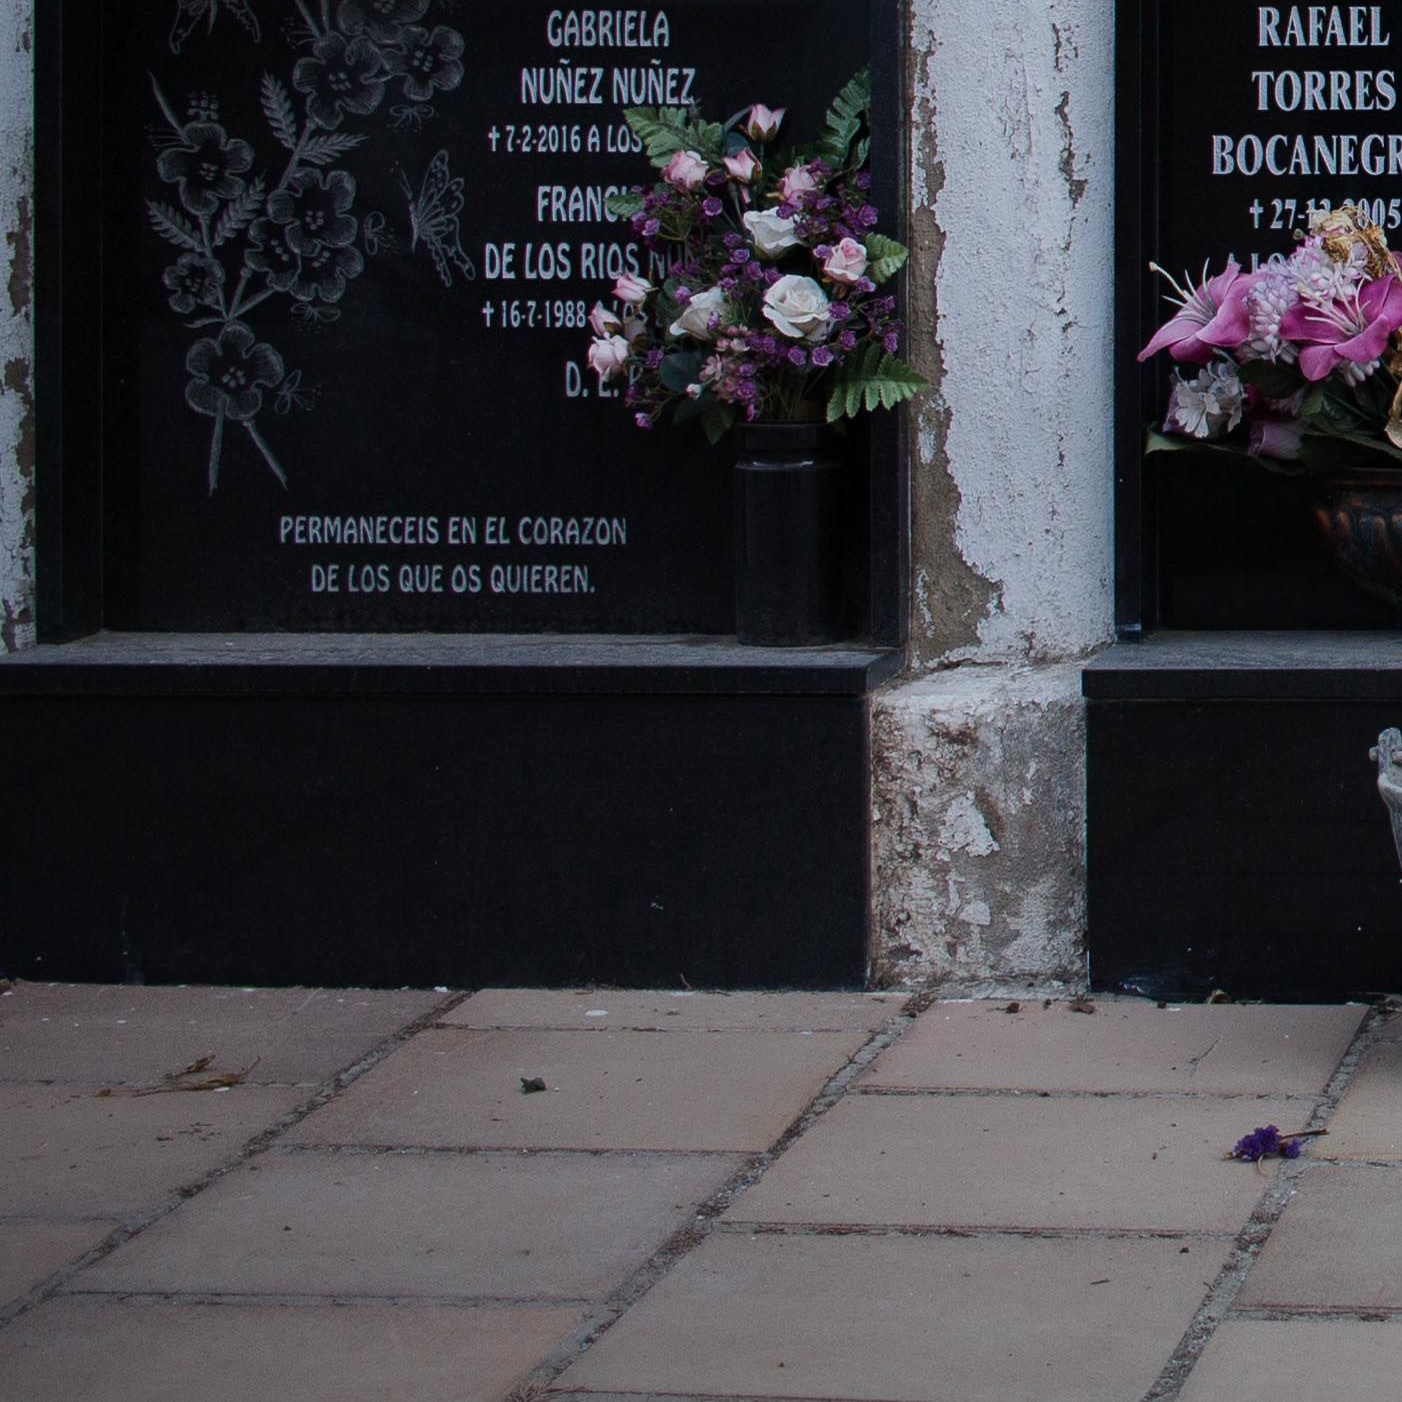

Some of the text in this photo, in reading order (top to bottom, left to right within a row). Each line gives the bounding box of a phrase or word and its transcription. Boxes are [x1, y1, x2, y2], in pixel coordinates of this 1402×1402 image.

[546, 9, 670, 47] GABRIELA
[1258, 5, 1390, 47] RAFAEL
[521, 58, 696, 105] NUÑEZ NUÑEZ
[1251, 69, 1397, 112] TORRES
[587, 124, 601, 153] A
[607, 125, 643, 152] LOS
[485, 242, 516, 279] DE
[524, 242, 571, 280] LOS
[581, 243, 639, 279] RIOS
[280, 515, 627, 546] PERMANECEIS EN EL CORAZON
[311, 564, 596, 594] DE LOS QUE OS QUIEREN.
